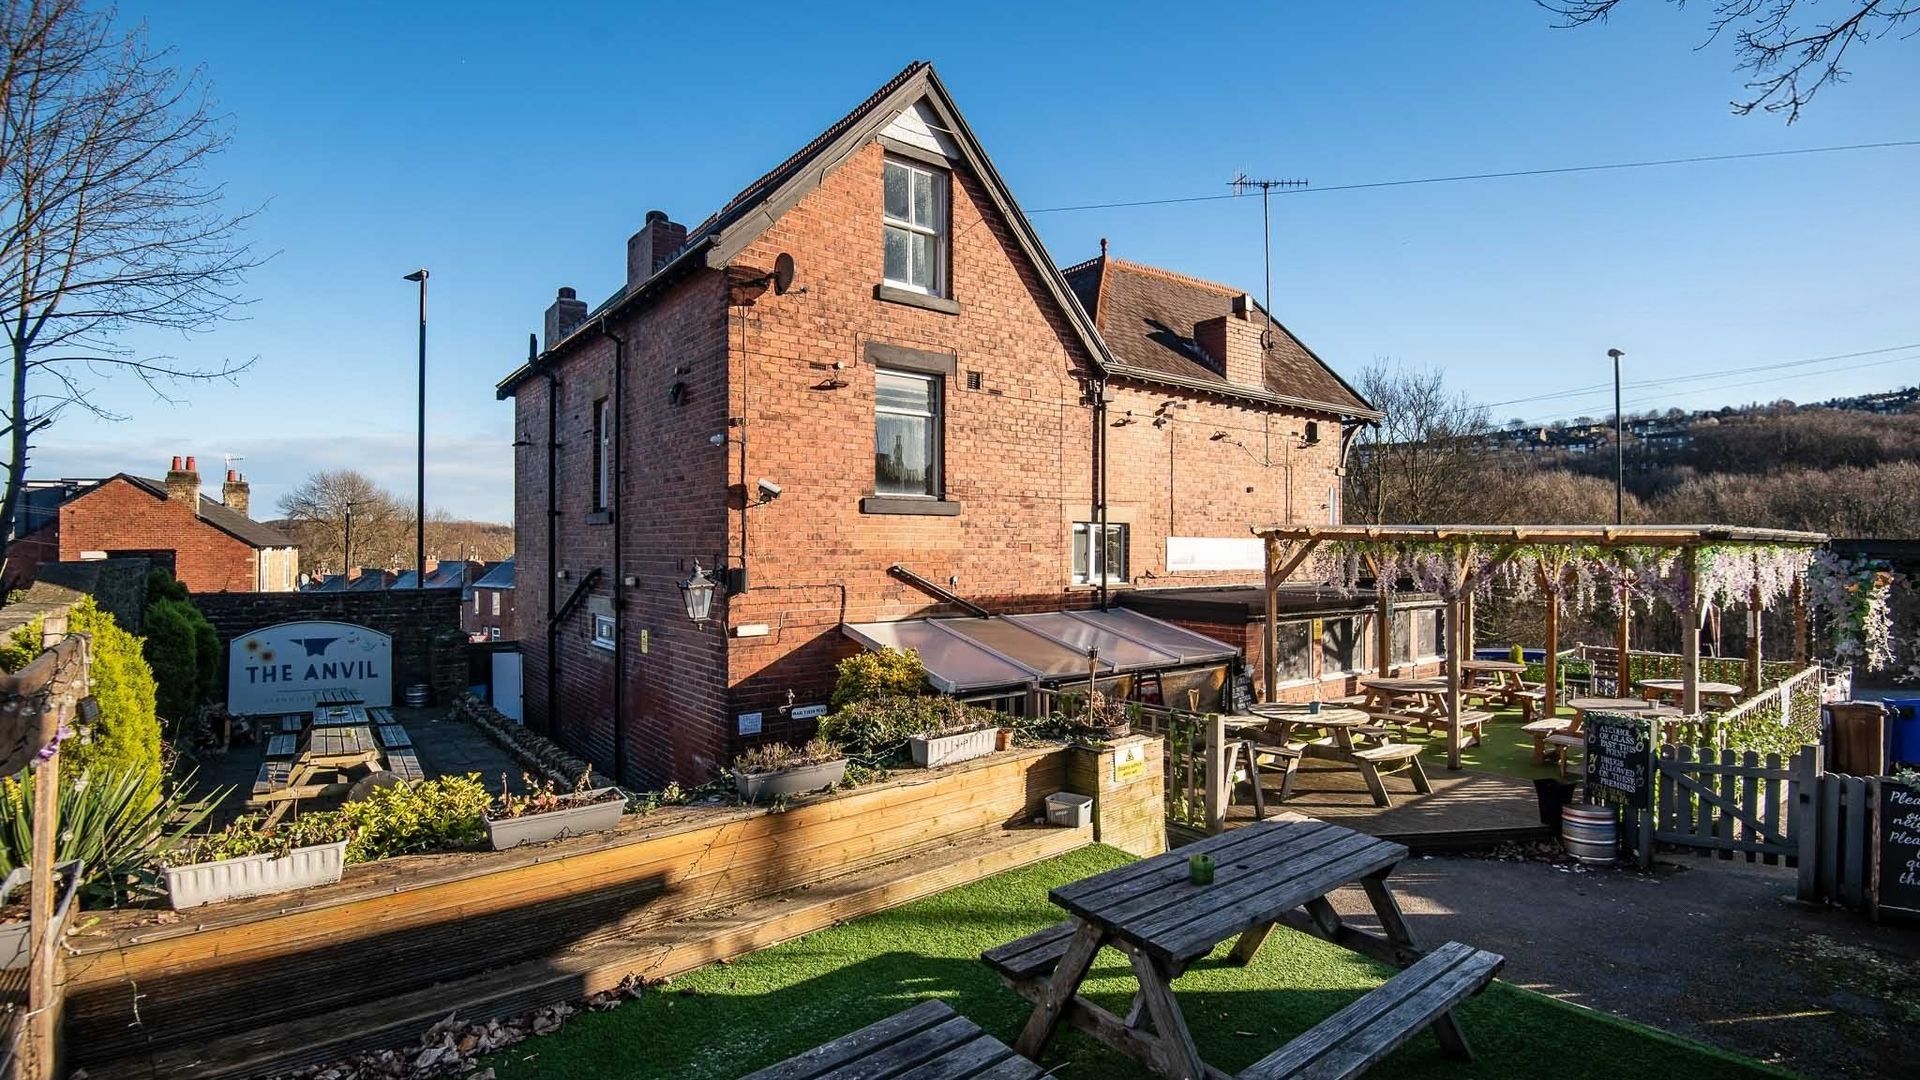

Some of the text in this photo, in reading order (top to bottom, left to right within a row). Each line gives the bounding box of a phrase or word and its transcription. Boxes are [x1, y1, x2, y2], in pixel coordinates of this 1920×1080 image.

[246, 661, 378, 683] THE ANVIL
[1600, 725, 1631, 736] ALCOHOL
[1612, 734, 1634, 744] GLASS
[1600, 739, 1636, 753] PAST THIS
[1606, 747, 1627, 758] POINT
[1602, 755, 1624, 766] DRUGS
[1600, 763, 1635, 776] ALLOWED
[1600, 769, 1608, 777] ON
[1600, 777, 1636, 792] PREMISES
